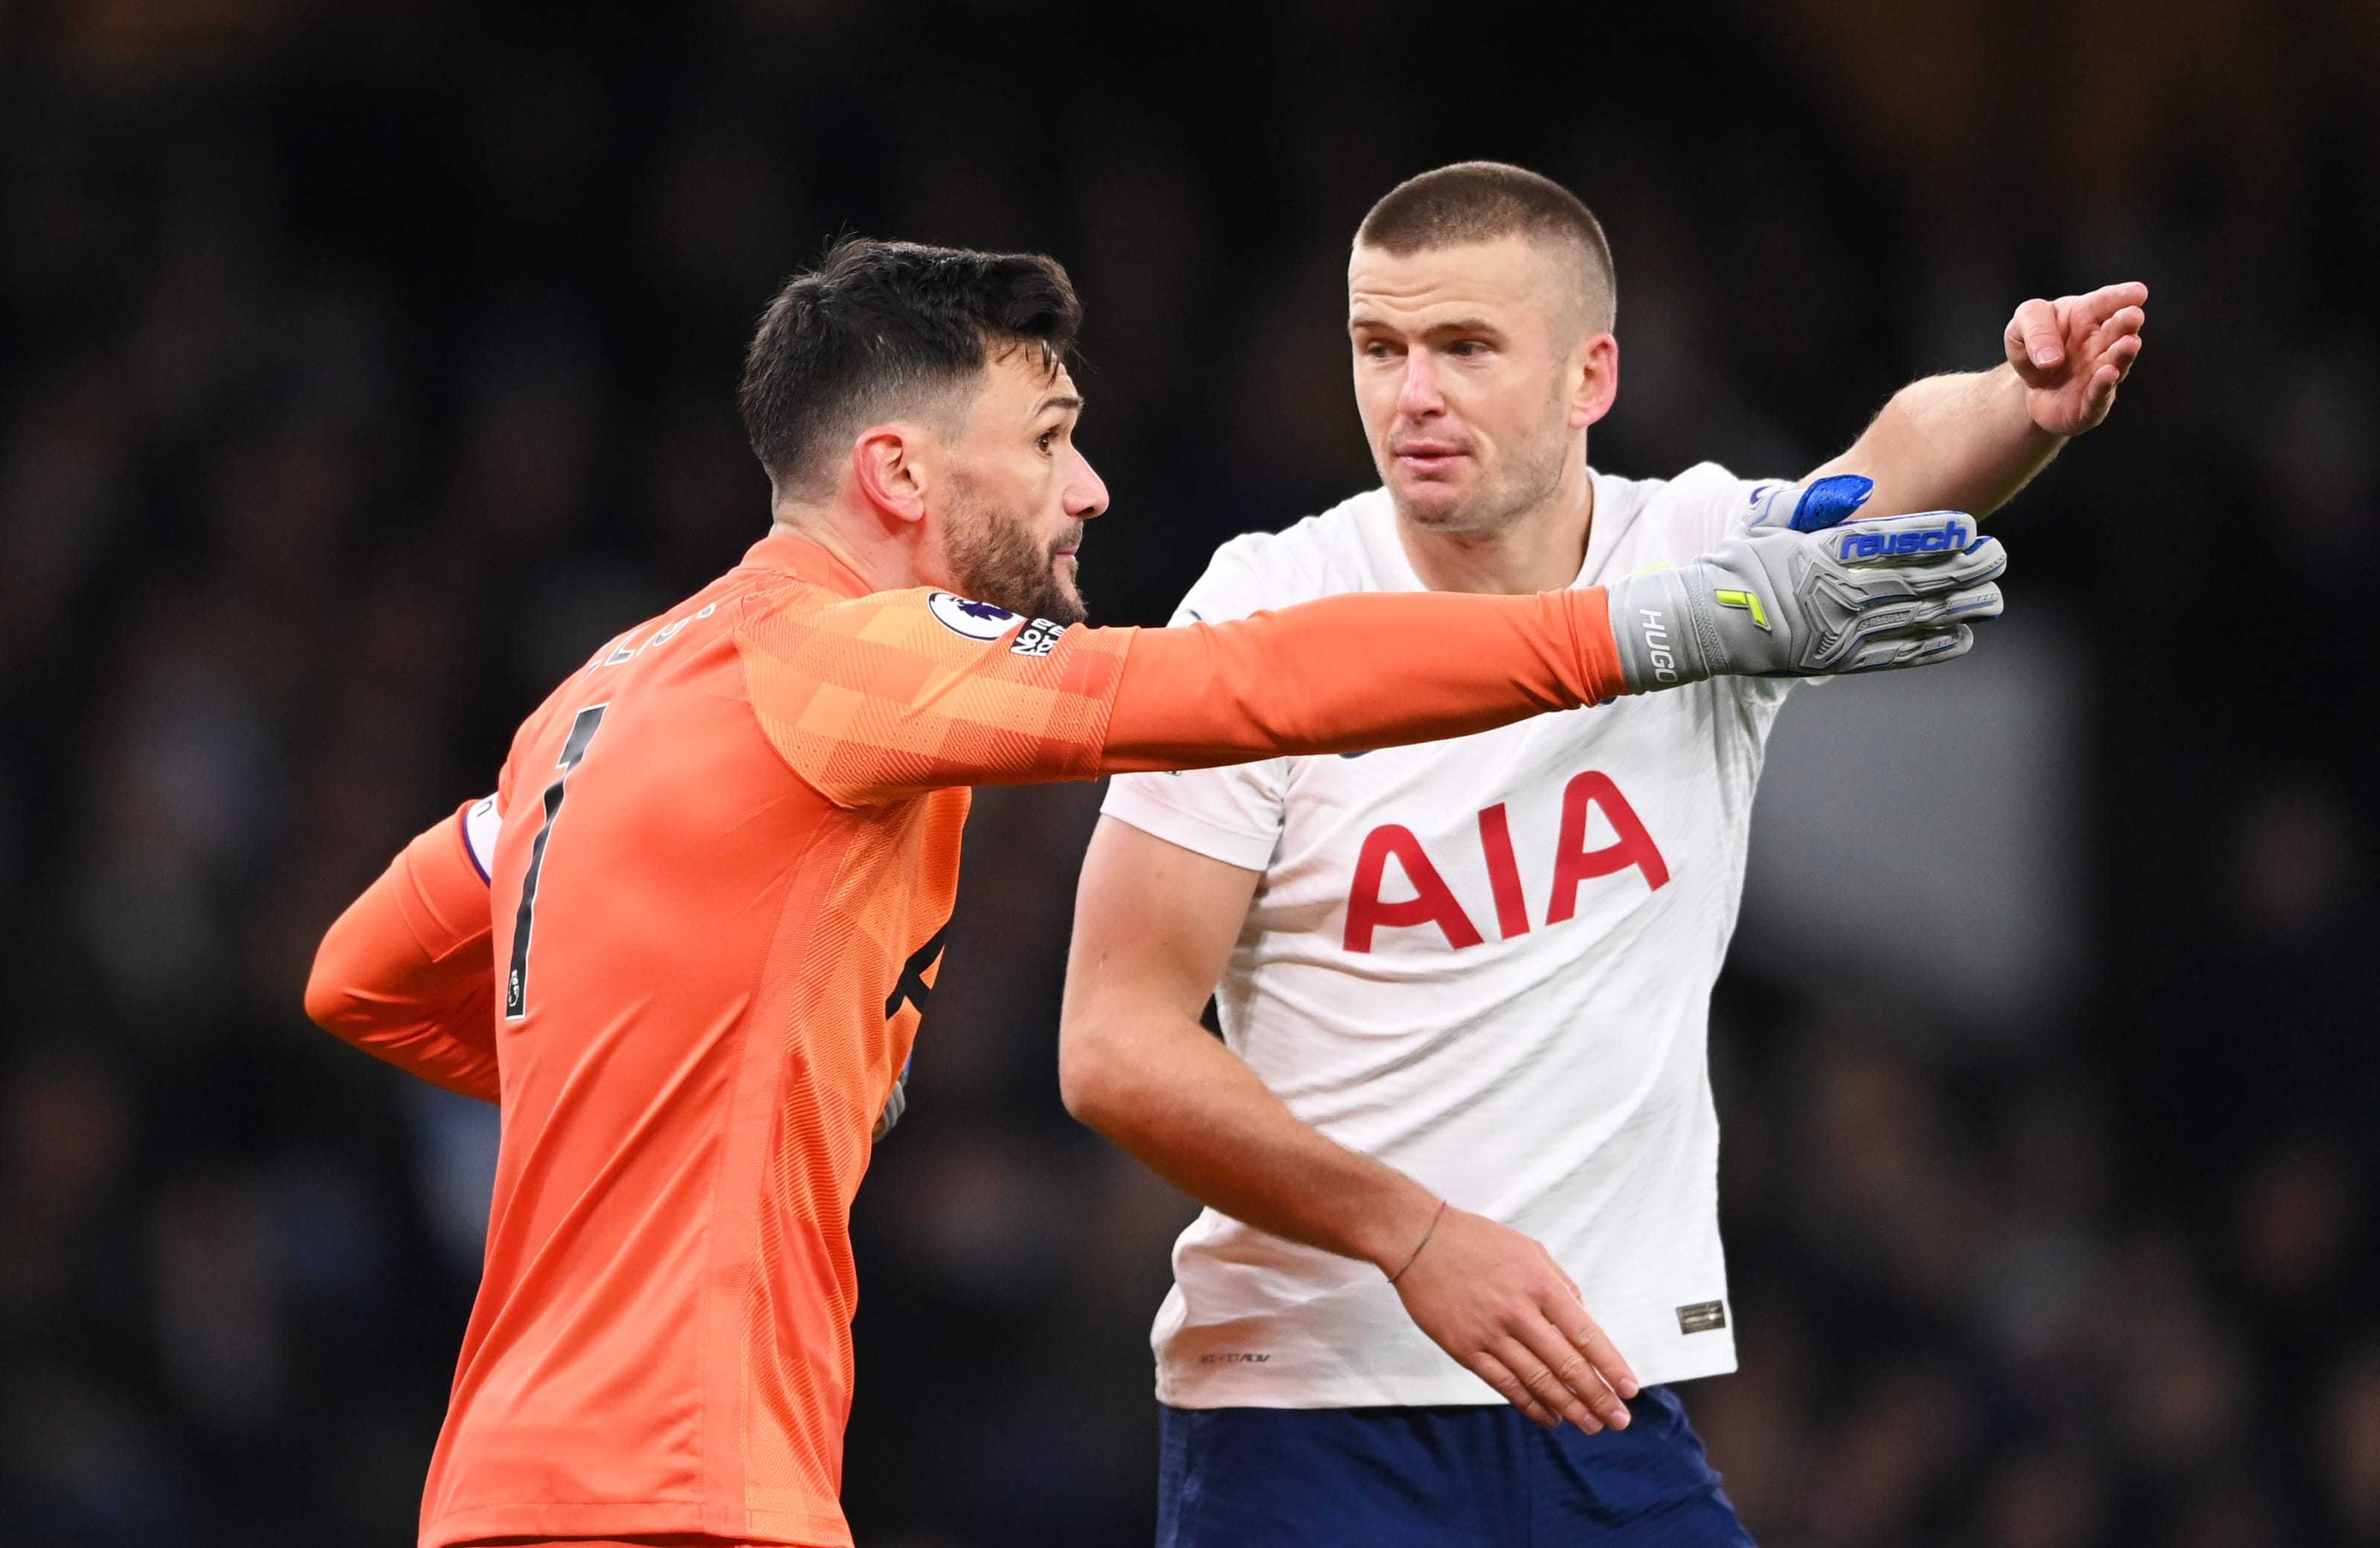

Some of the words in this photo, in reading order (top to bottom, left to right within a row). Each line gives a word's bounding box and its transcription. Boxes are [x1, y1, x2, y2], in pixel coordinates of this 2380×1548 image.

[1840, 520, 1967, 559] reusch
[1638, 609, 1679, 683] HUGO
[506, 702, 609, 1019] 1
[1343, 770, 1670, 954] AIA
